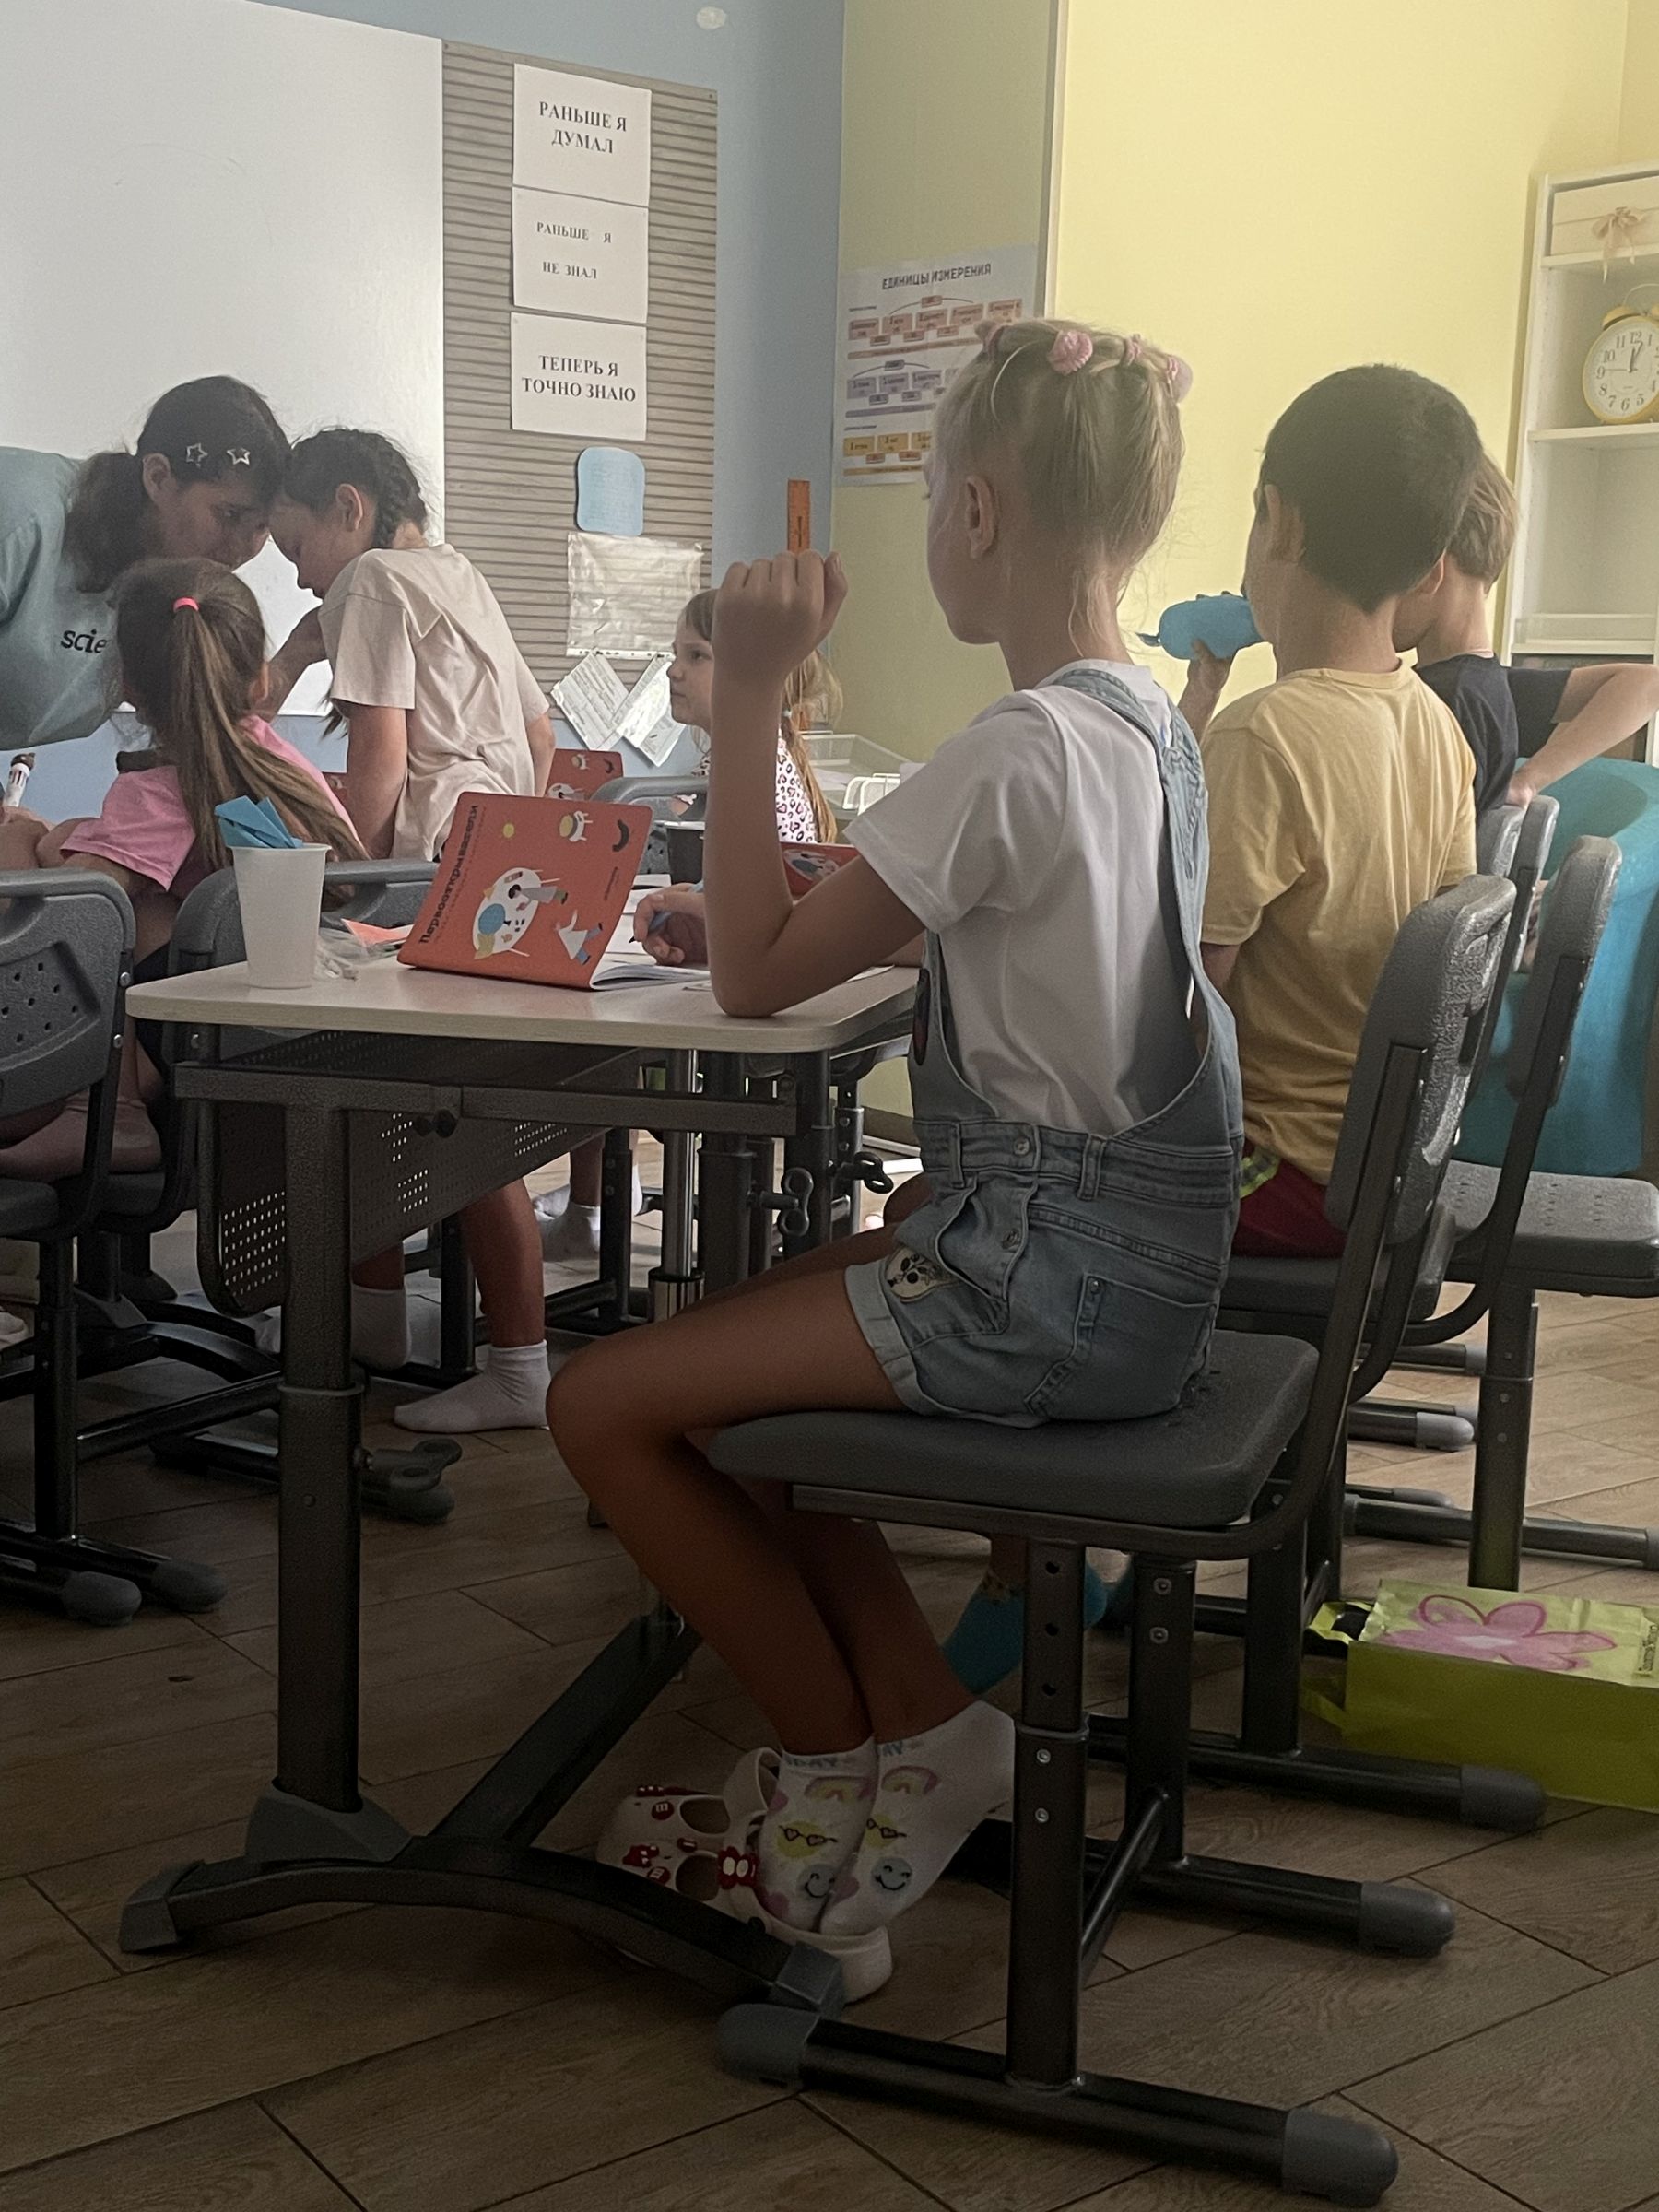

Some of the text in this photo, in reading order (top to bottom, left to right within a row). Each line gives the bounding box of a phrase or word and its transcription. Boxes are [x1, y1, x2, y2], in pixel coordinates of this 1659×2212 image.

[539, 101, 627, 132] РАНЬШЕ Я
[551, 129, 614, 154] ДУМАЛ
[536, 221, 612, 243] РАНЬШЕ Я
[542, 261, 598, 279] НЕ ЗНАЛ
[882, 264, 991, 290] ЕДИНИЦЫ ИЗМЕРЕНИЯ
[538, 355, 618, 377] ТЕПЕРЬ Я
[522, 377, 636, 402] ТОЧНО ЗНАЮ
